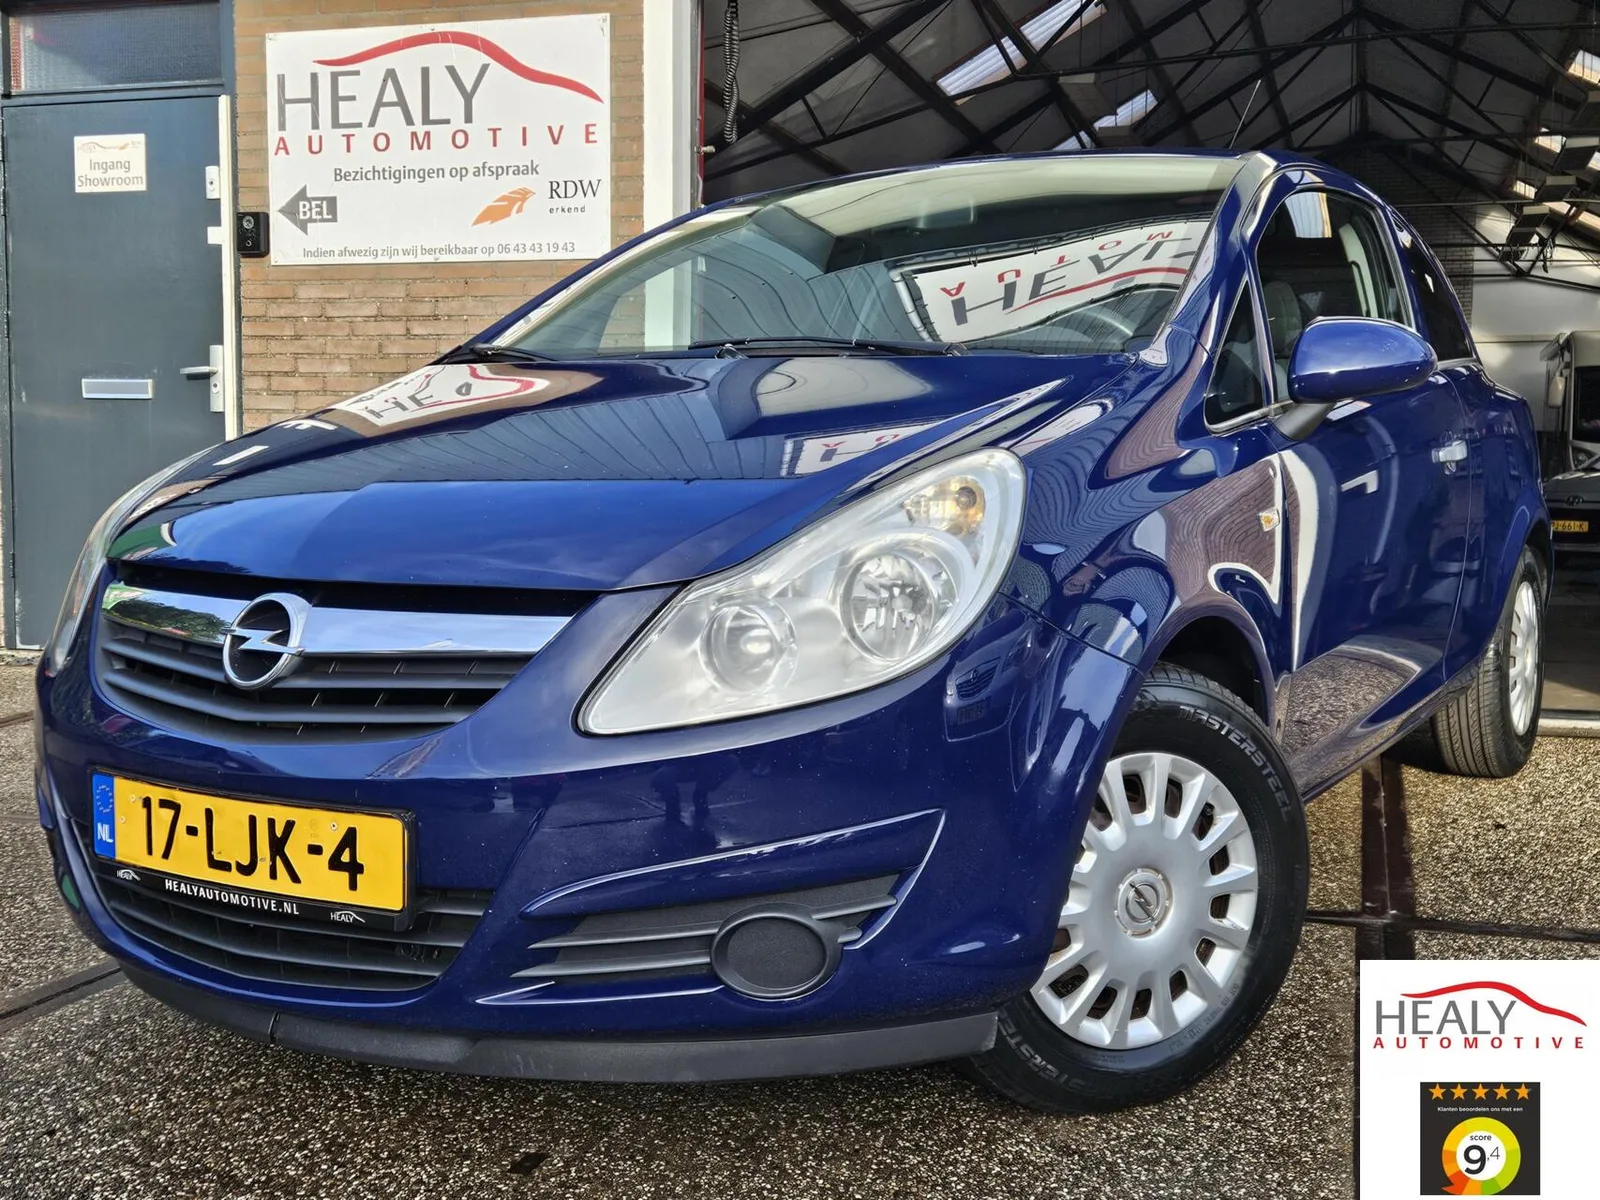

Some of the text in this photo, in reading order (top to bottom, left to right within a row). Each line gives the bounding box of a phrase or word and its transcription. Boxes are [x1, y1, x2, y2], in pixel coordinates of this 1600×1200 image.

[277, 63, 491, 131] HEALY
[274, 123, 597, 155] AUTOMOTIVE
[90, 159, 131, 174] Ingang
[334, 159, 539, 184] Bezichtigingen op afspraak
[78, 174, 143, 188] Showroom
[548, 179, 602, 199] RDW
[299, 200, 332, 220] BEL
[549, 205, 586, 214] erkend
[303, 242, 576, 259] Indien afwezig zijn wij bereikbaar op 06 43 43 19 43
[97, 822, 114, 843] NL
[142, 796, 364, 891] 17-LJK-4
[165, 879, 299, 915] HEALYAUTOMOTIVE.NL
[330, 911, 354, 923] HEALY
